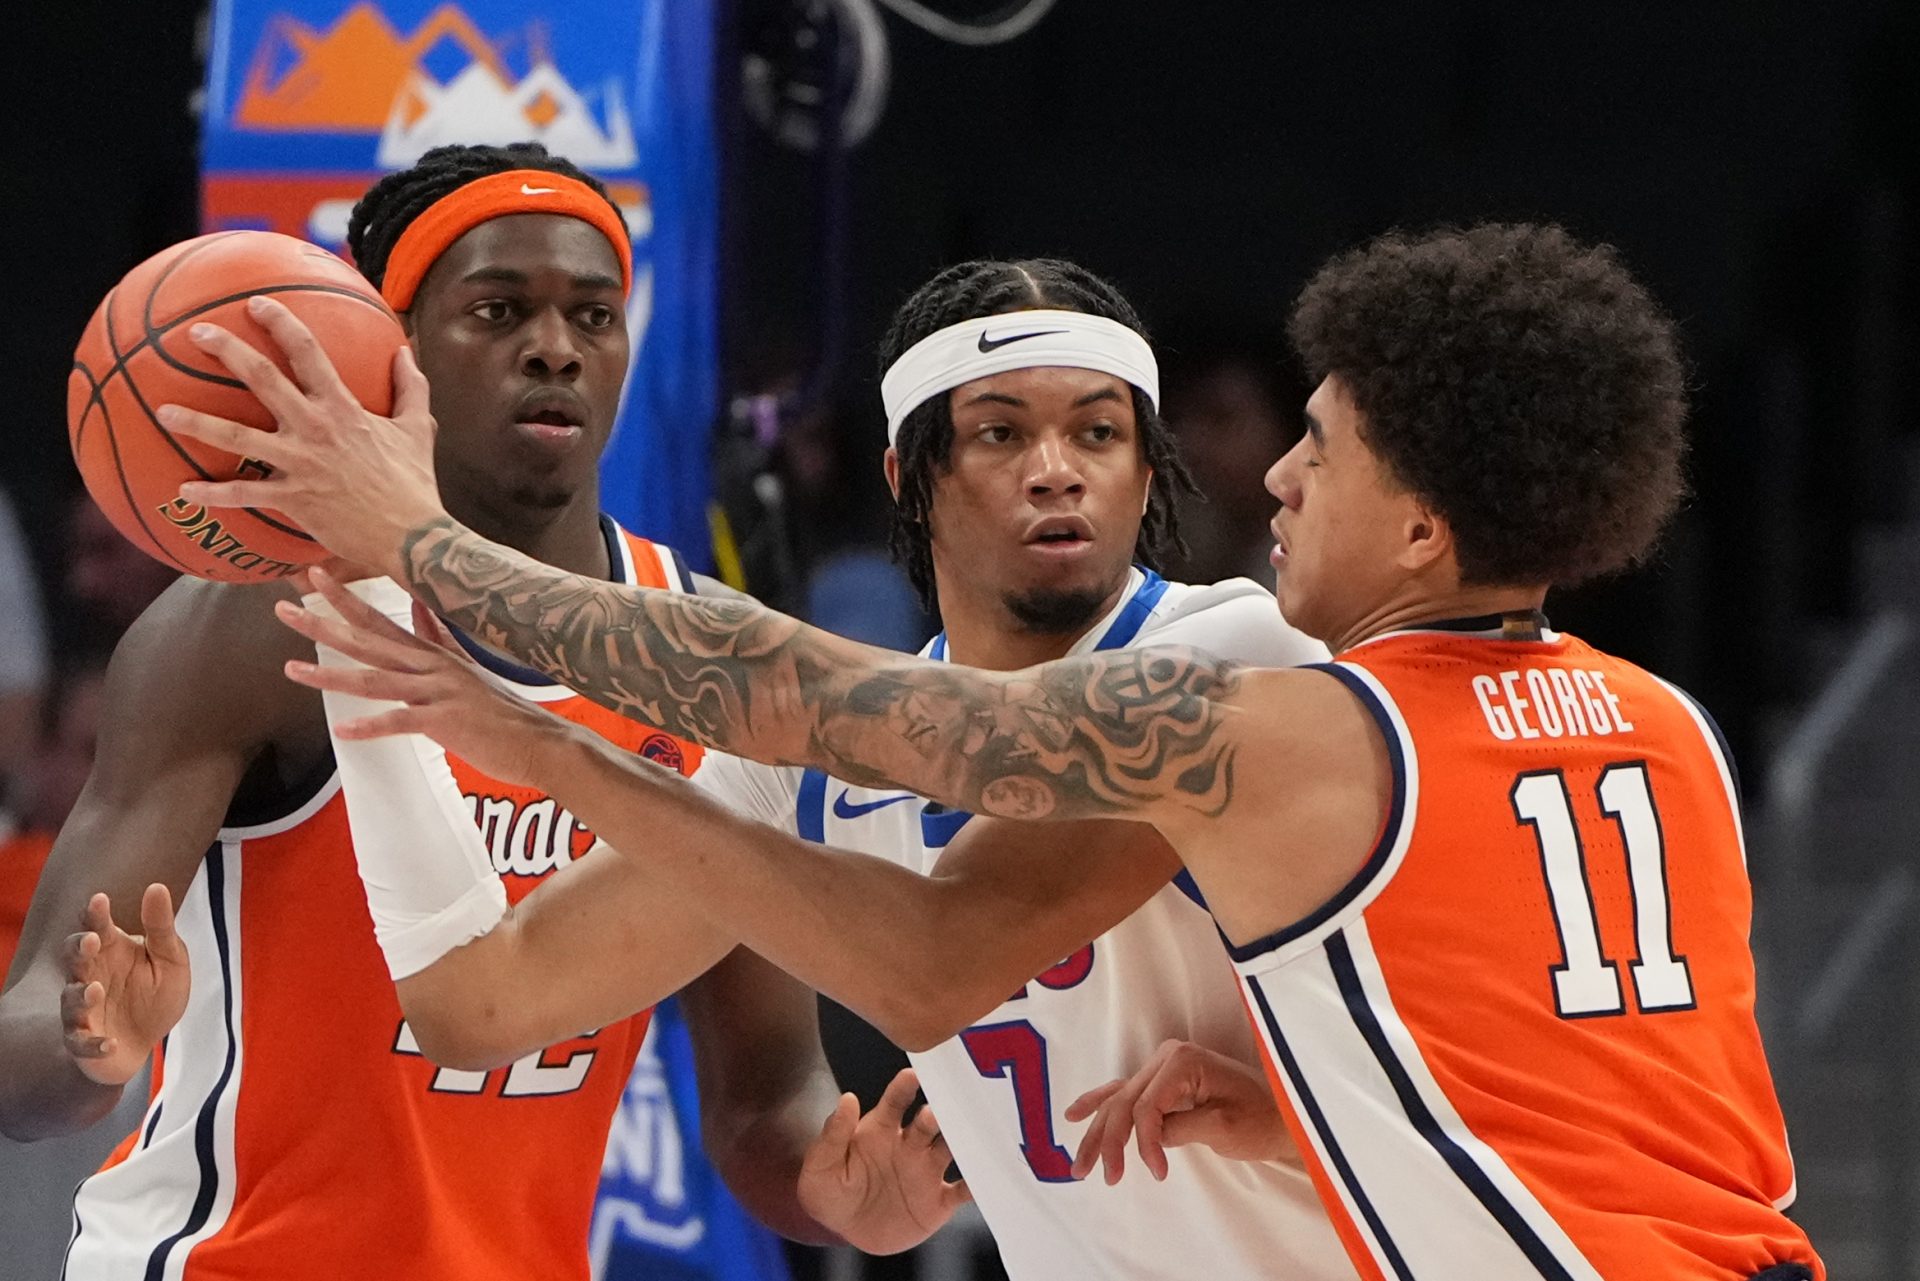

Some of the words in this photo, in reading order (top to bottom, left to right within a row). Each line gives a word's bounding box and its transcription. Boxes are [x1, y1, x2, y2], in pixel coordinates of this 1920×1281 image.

[1472, 668, 1634, 741] GEORGE
[1509, 760, 1697, 1019] 11
[959, 1019, 1085, 1183] 7
